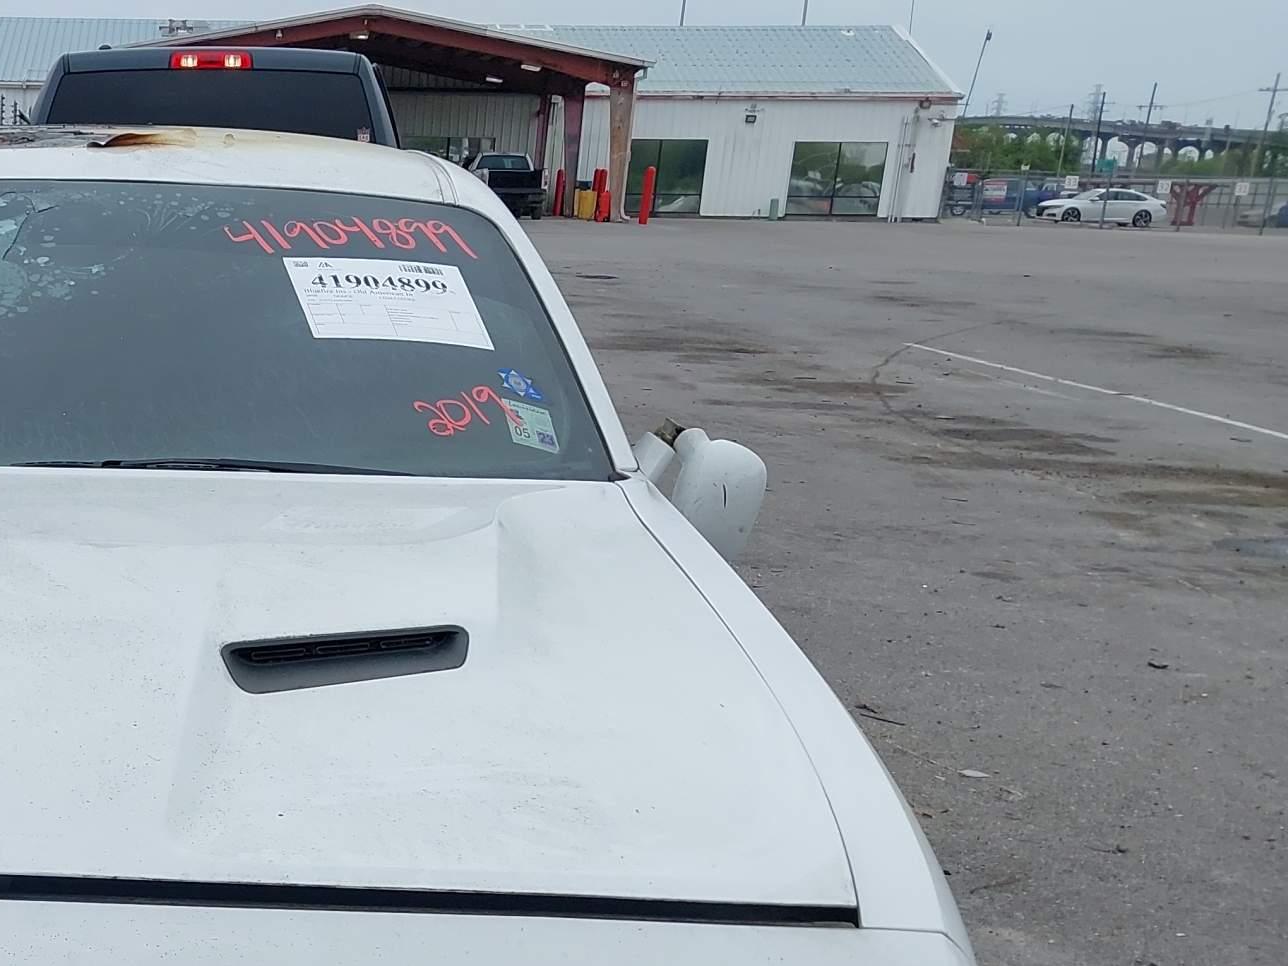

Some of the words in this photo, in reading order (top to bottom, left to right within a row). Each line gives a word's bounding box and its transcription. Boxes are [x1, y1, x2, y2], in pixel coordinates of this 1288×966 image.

[223, 216, 478, 260] 41904899
[311, 273, 448, 295] 41904899
[413, 385, 523, 437] 2019
[514, 425, 531, 439] 05
